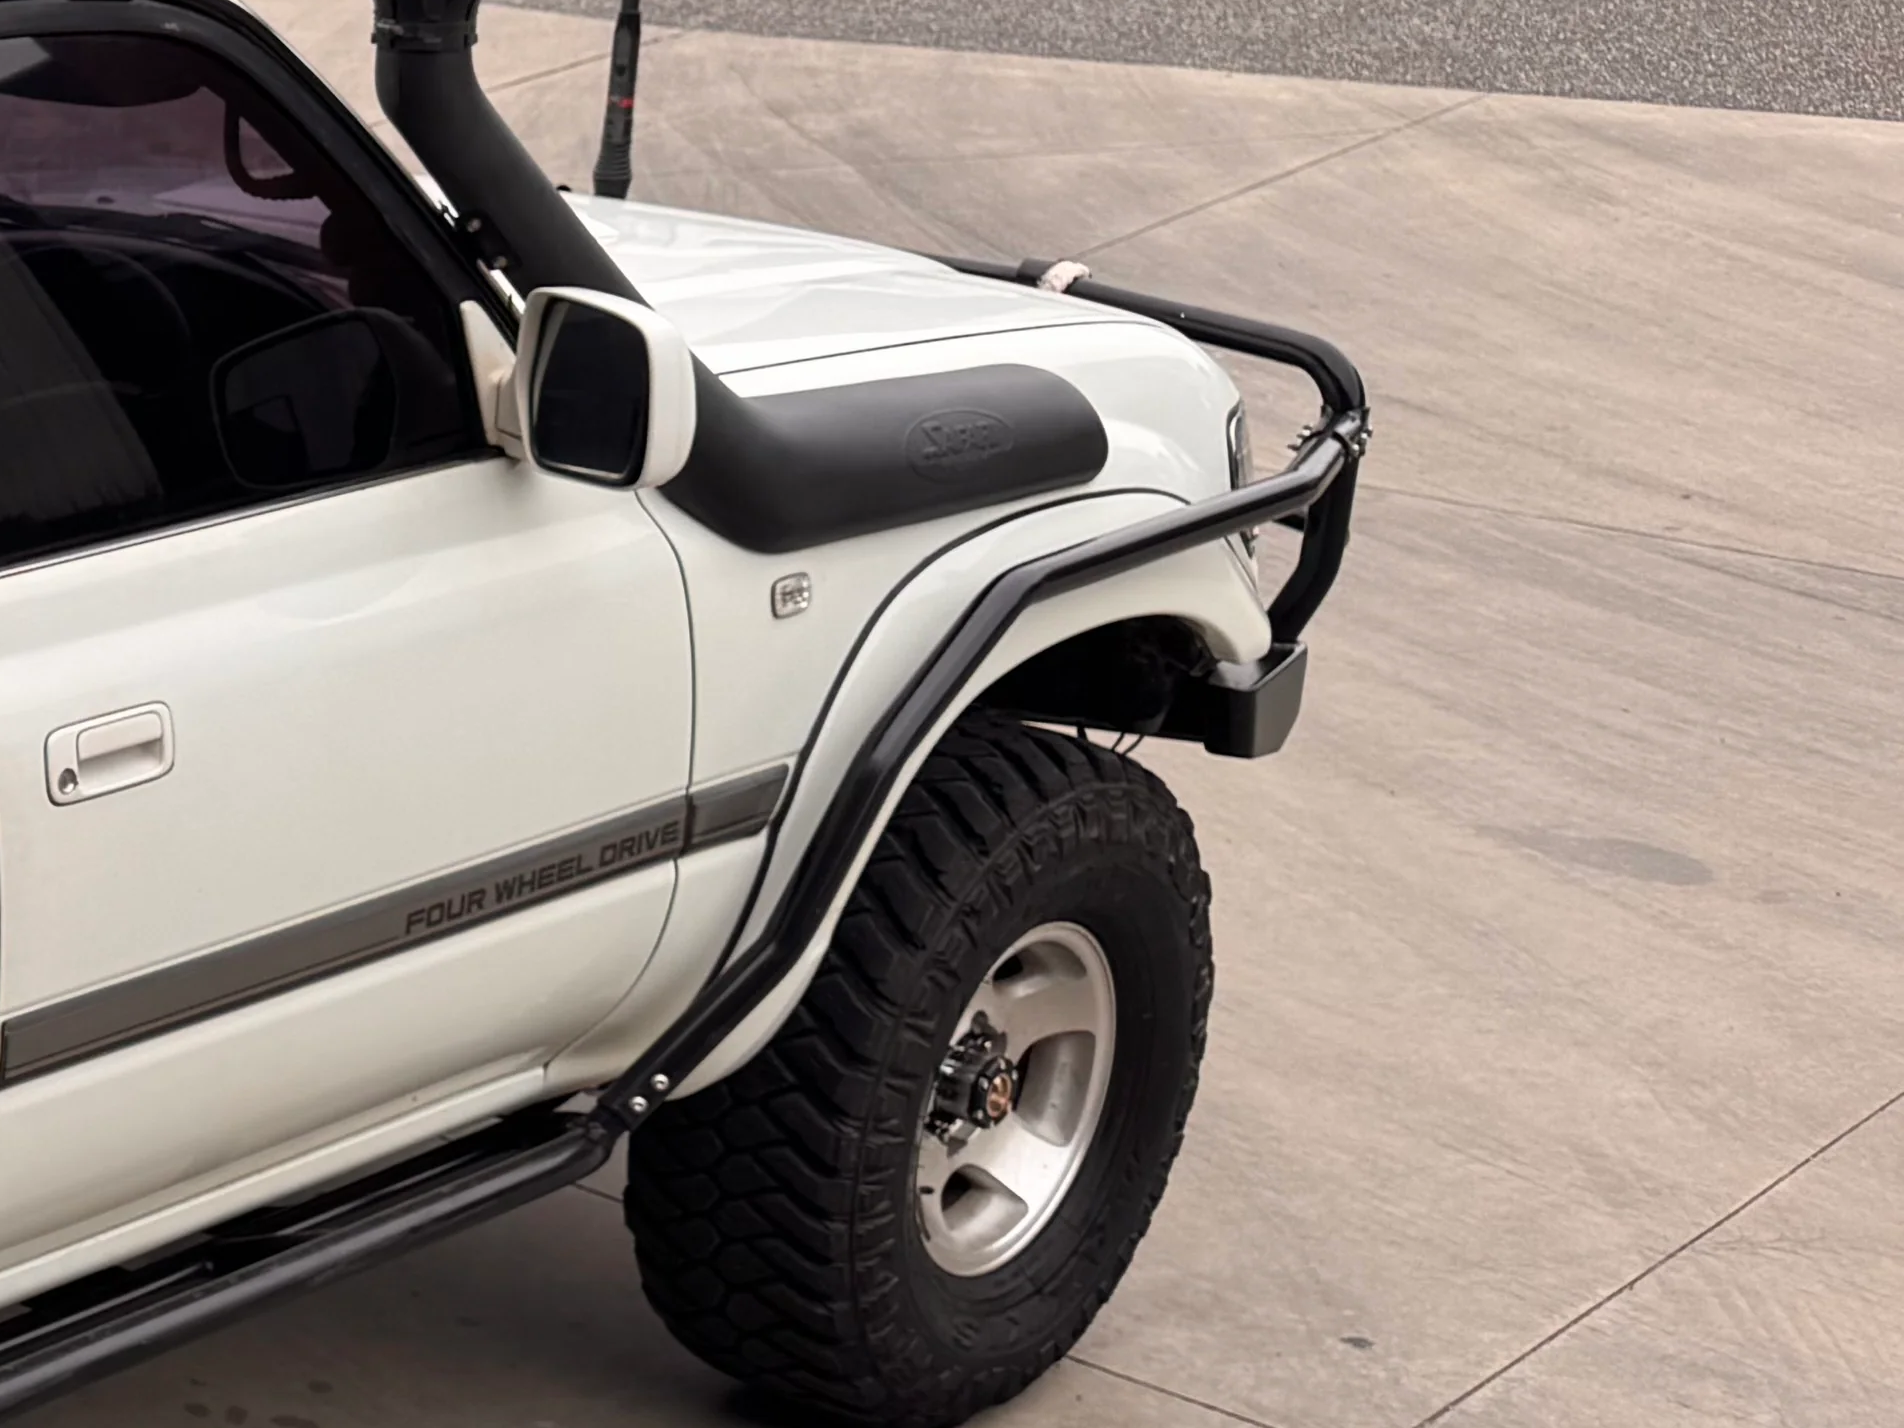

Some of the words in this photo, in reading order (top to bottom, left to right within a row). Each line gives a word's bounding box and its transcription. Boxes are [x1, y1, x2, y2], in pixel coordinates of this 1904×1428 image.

[404, 888, 488, 936] FOUR
[494, 854, 592, 904] WHEEL
[597, 820, 681, 866] DRIVE
